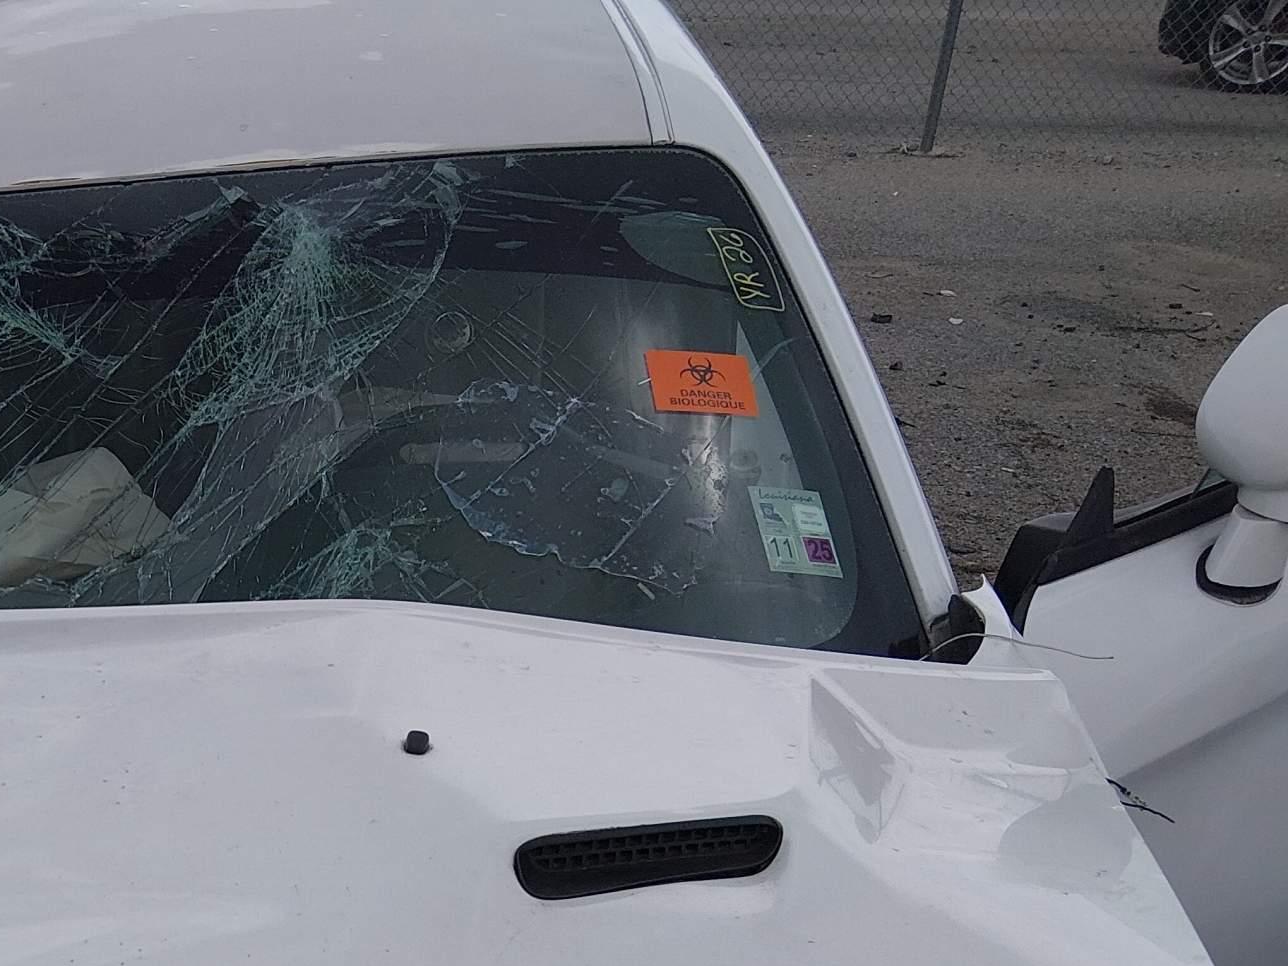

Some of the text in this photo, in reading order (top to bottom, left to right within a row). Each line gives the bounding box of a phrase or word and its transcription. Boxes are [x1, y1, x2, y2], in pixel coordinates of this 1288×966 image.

[680, 388, 732, 401] DANGER
[669, 396, 746, 410] BIOLOGIQUE
[769, 537, 834, 561] 11 25
